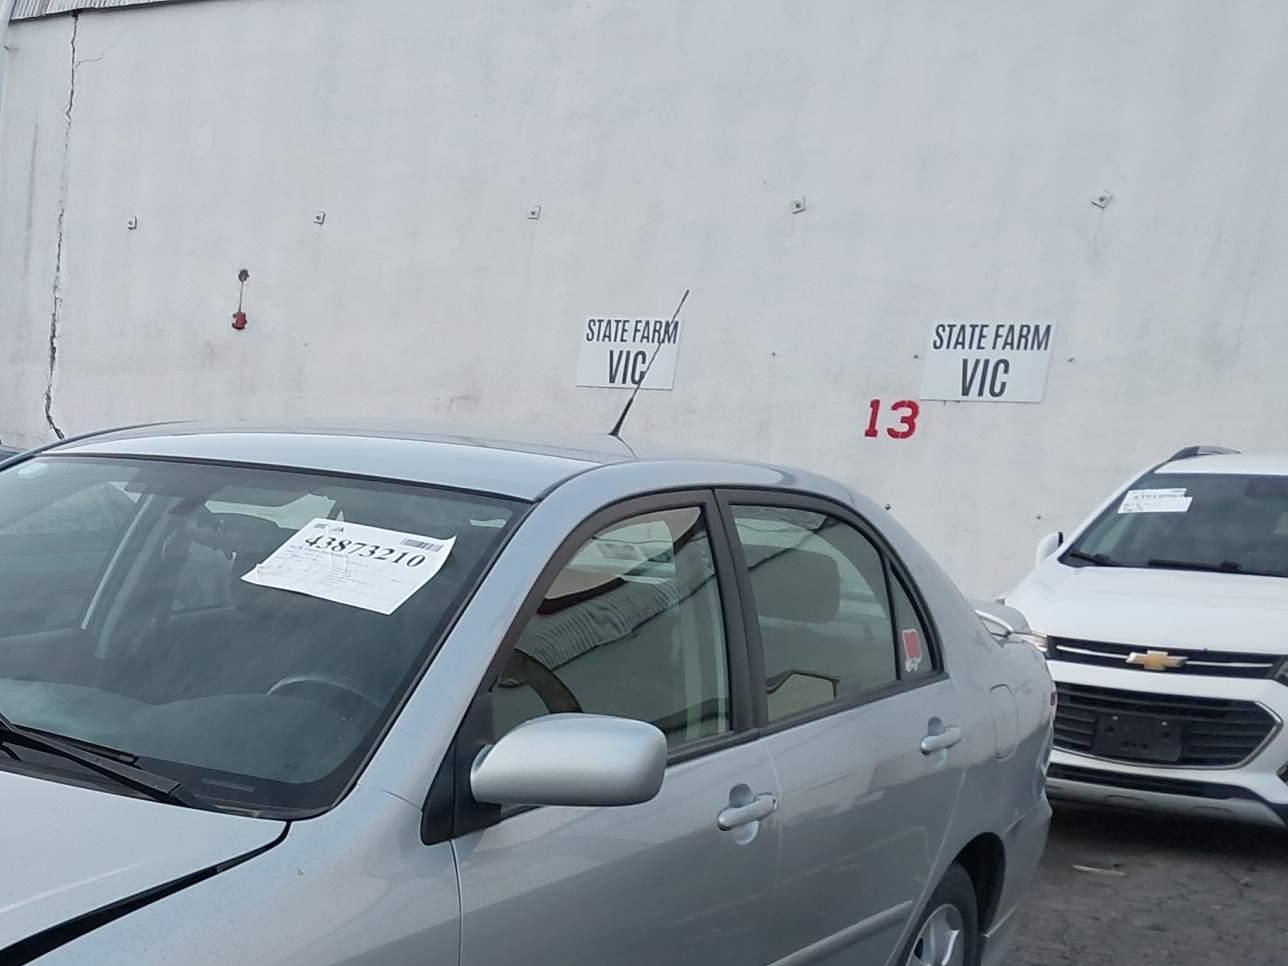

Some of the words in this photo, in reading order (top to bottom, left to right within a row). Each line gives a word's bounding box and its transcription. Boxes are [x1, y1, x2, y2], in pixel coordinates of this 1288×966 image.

[586, 318, 630, 343] STATE
[632, 319, 679, 345] FARM
[932, 323, 989, 350] STATE
[992, 323, 1052, 351] FARM
[608, 349, 646, 385] VIC
[961, 358, 1010, 398] VIC
[864, 398, 920, 440] 13
[304, 534, 428, 569] 43873210
